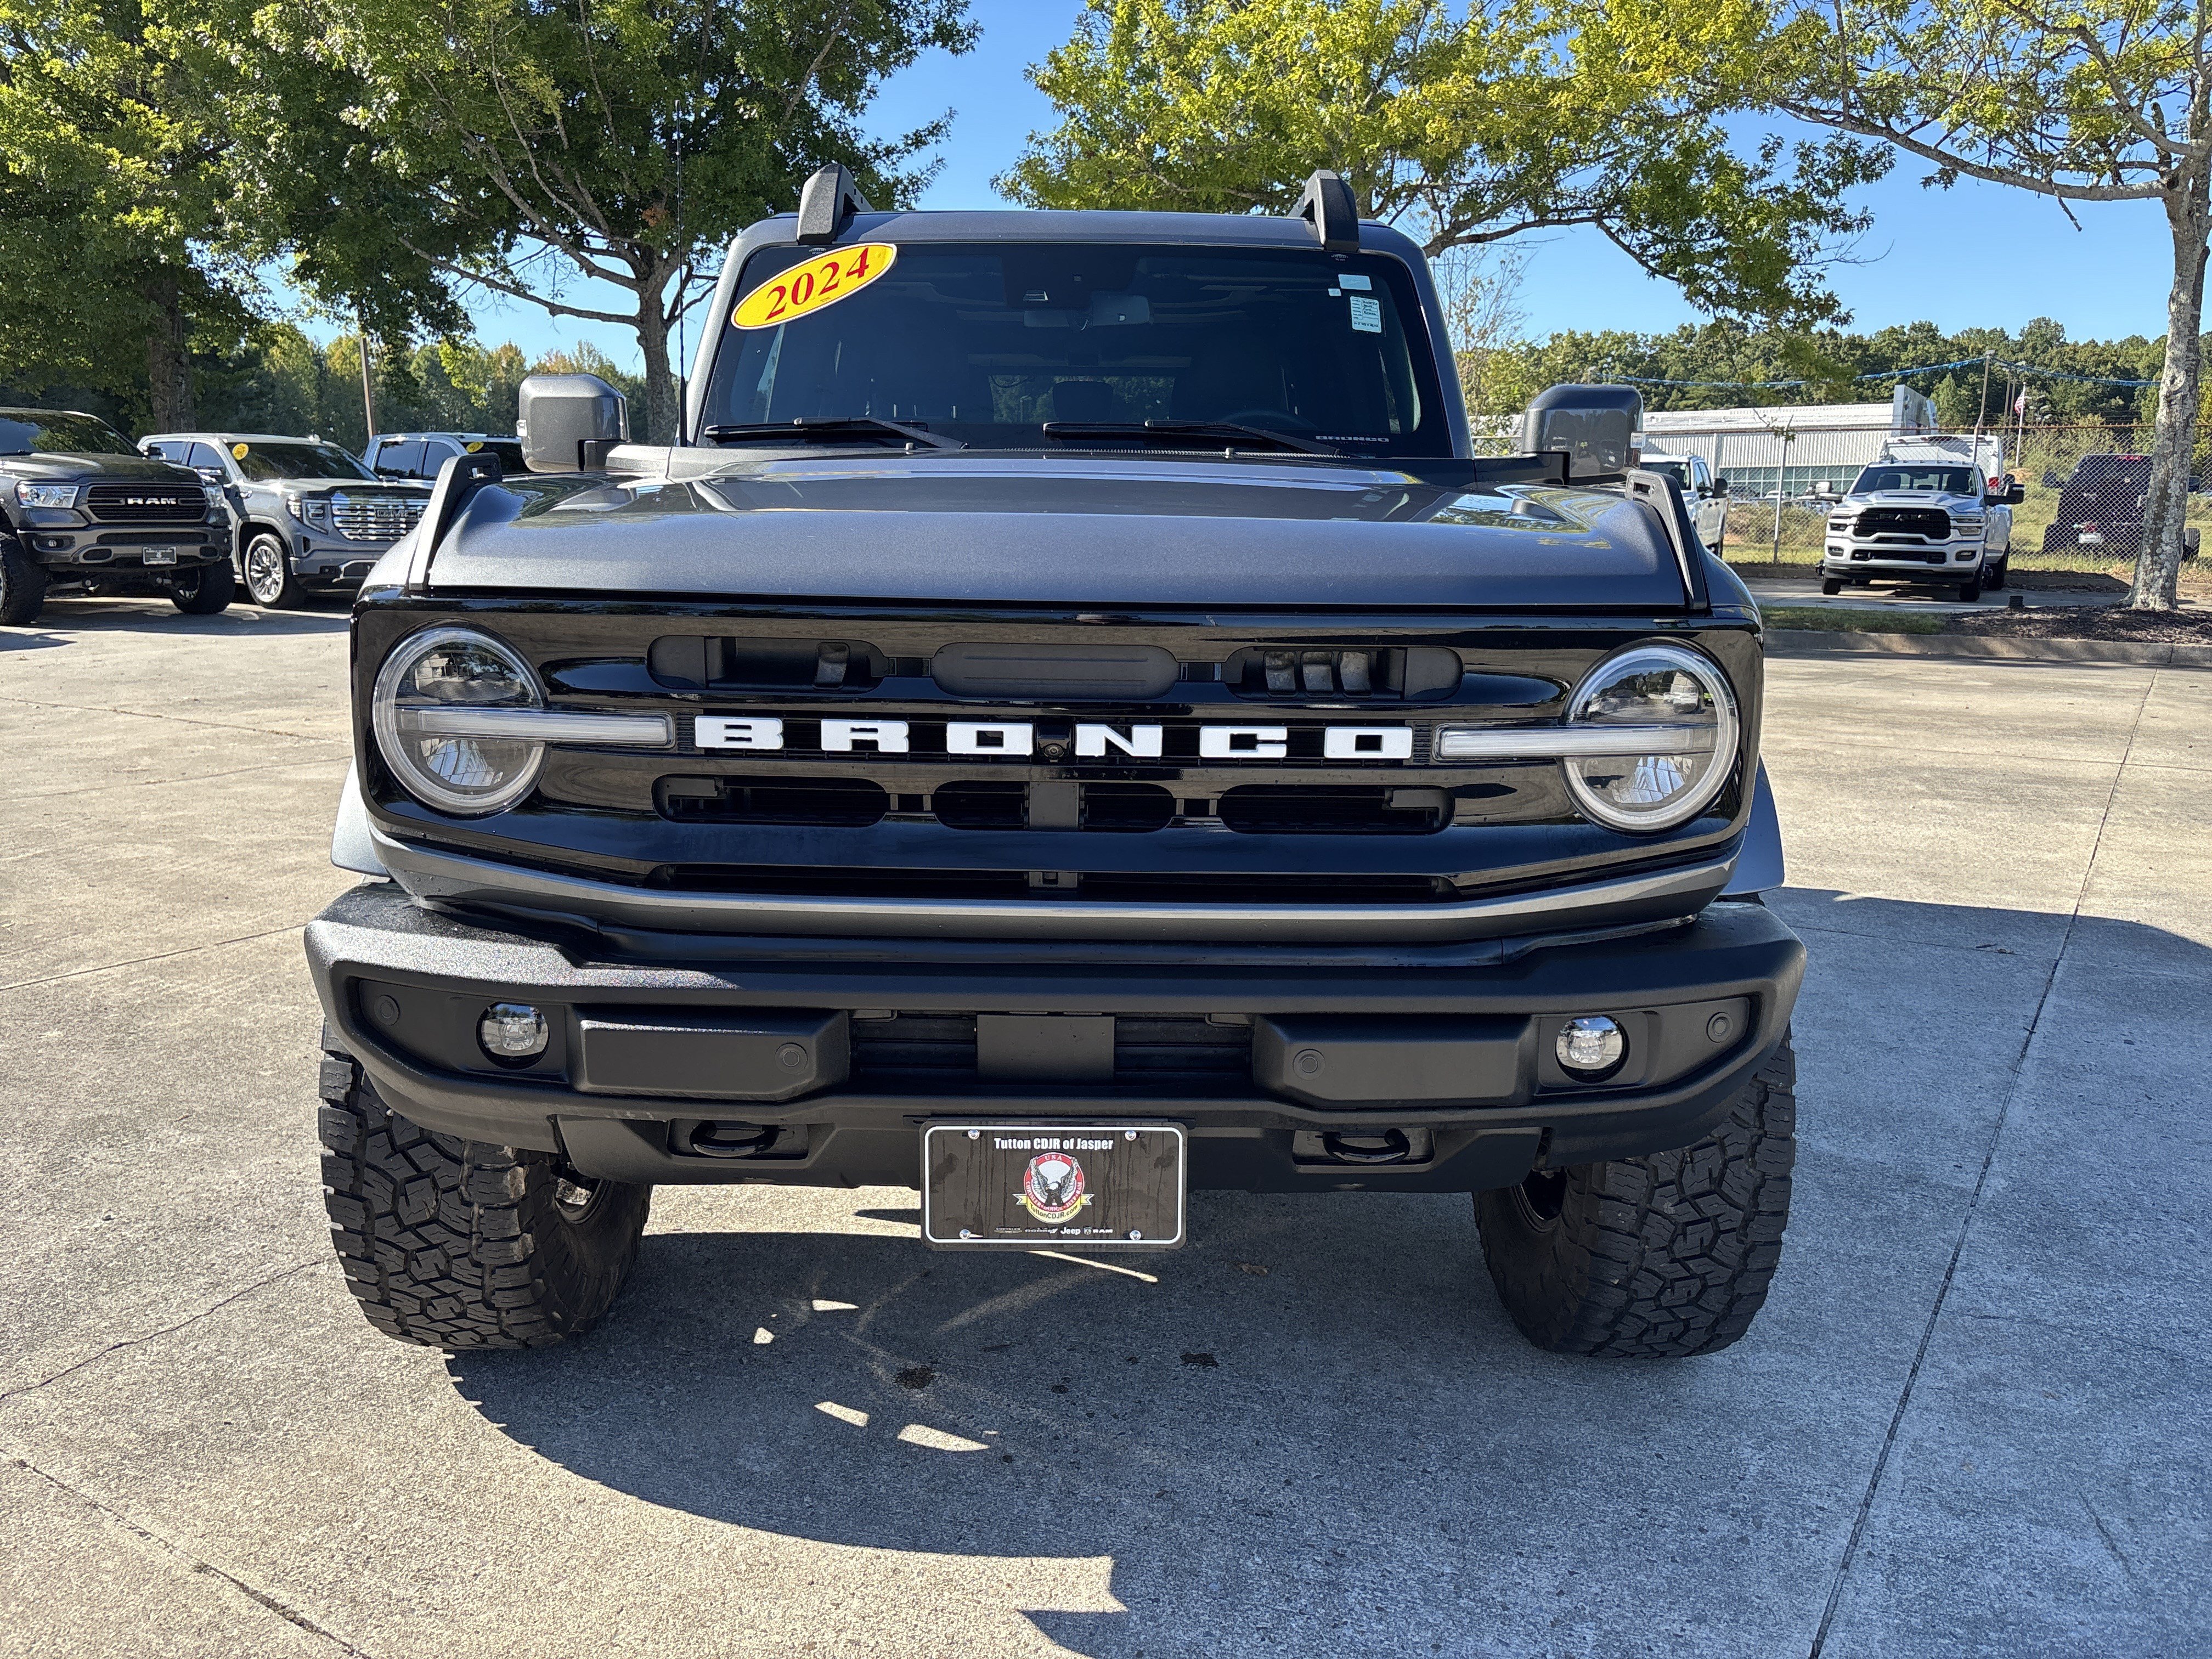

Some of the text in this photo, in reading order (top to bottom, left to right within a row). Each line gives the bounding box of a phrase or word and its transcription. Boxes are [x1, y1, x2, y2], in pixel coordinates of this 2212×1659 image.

[765, 247, 869, 321] 2024
[695, 715, 1413, 759] BRONCO
[994, 1138, 1114, 1150] Tutton CDJR of Jasper
[1030, 1203, 1079, 1219] TuttonCDJR.com
[1060, 1227, 1081, 1235] Jeep
